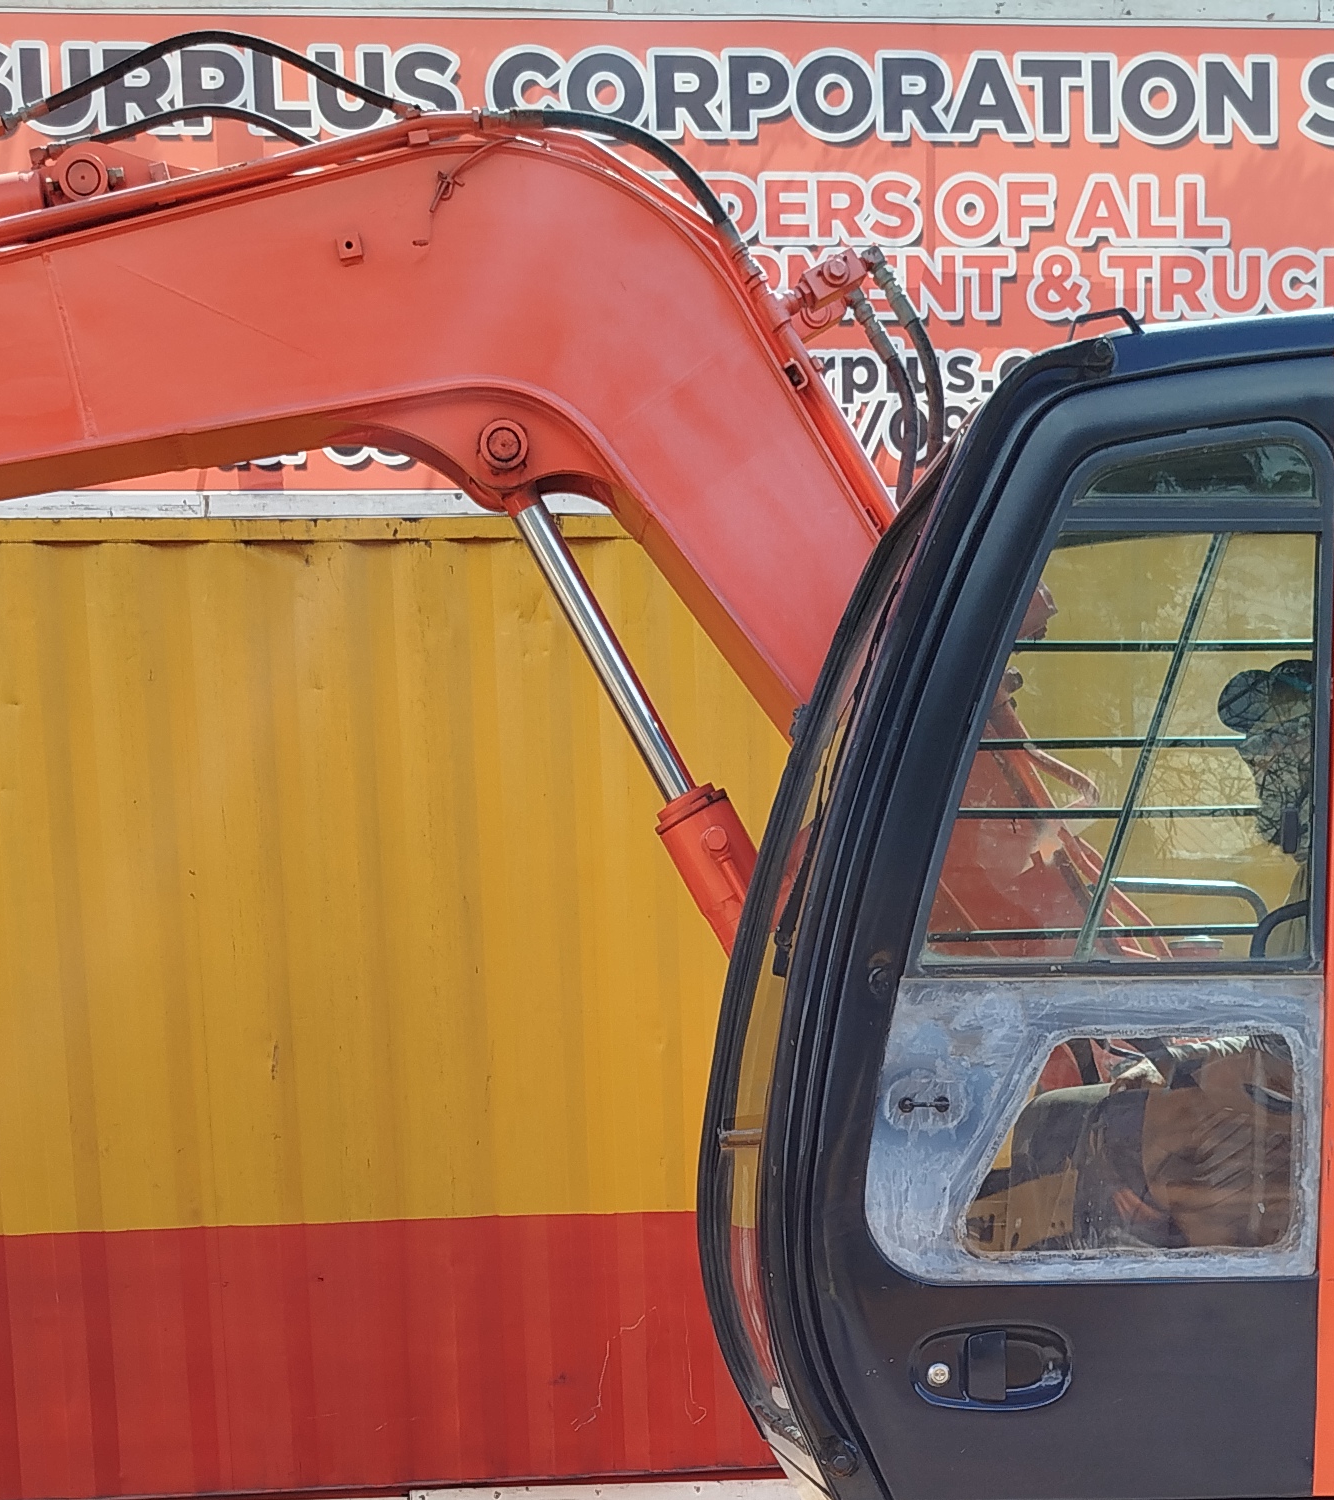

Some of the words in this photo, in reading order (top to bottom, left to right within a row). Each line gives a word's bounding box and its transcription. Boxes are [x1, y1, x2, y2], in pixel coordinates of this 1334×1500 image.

[484, 44, 1276, 144] CORPORATION
[935, 173, 1056, 247] OF
[1067, 174, 1229, 248] ALL
[1028, 248, 1090, 321] &
